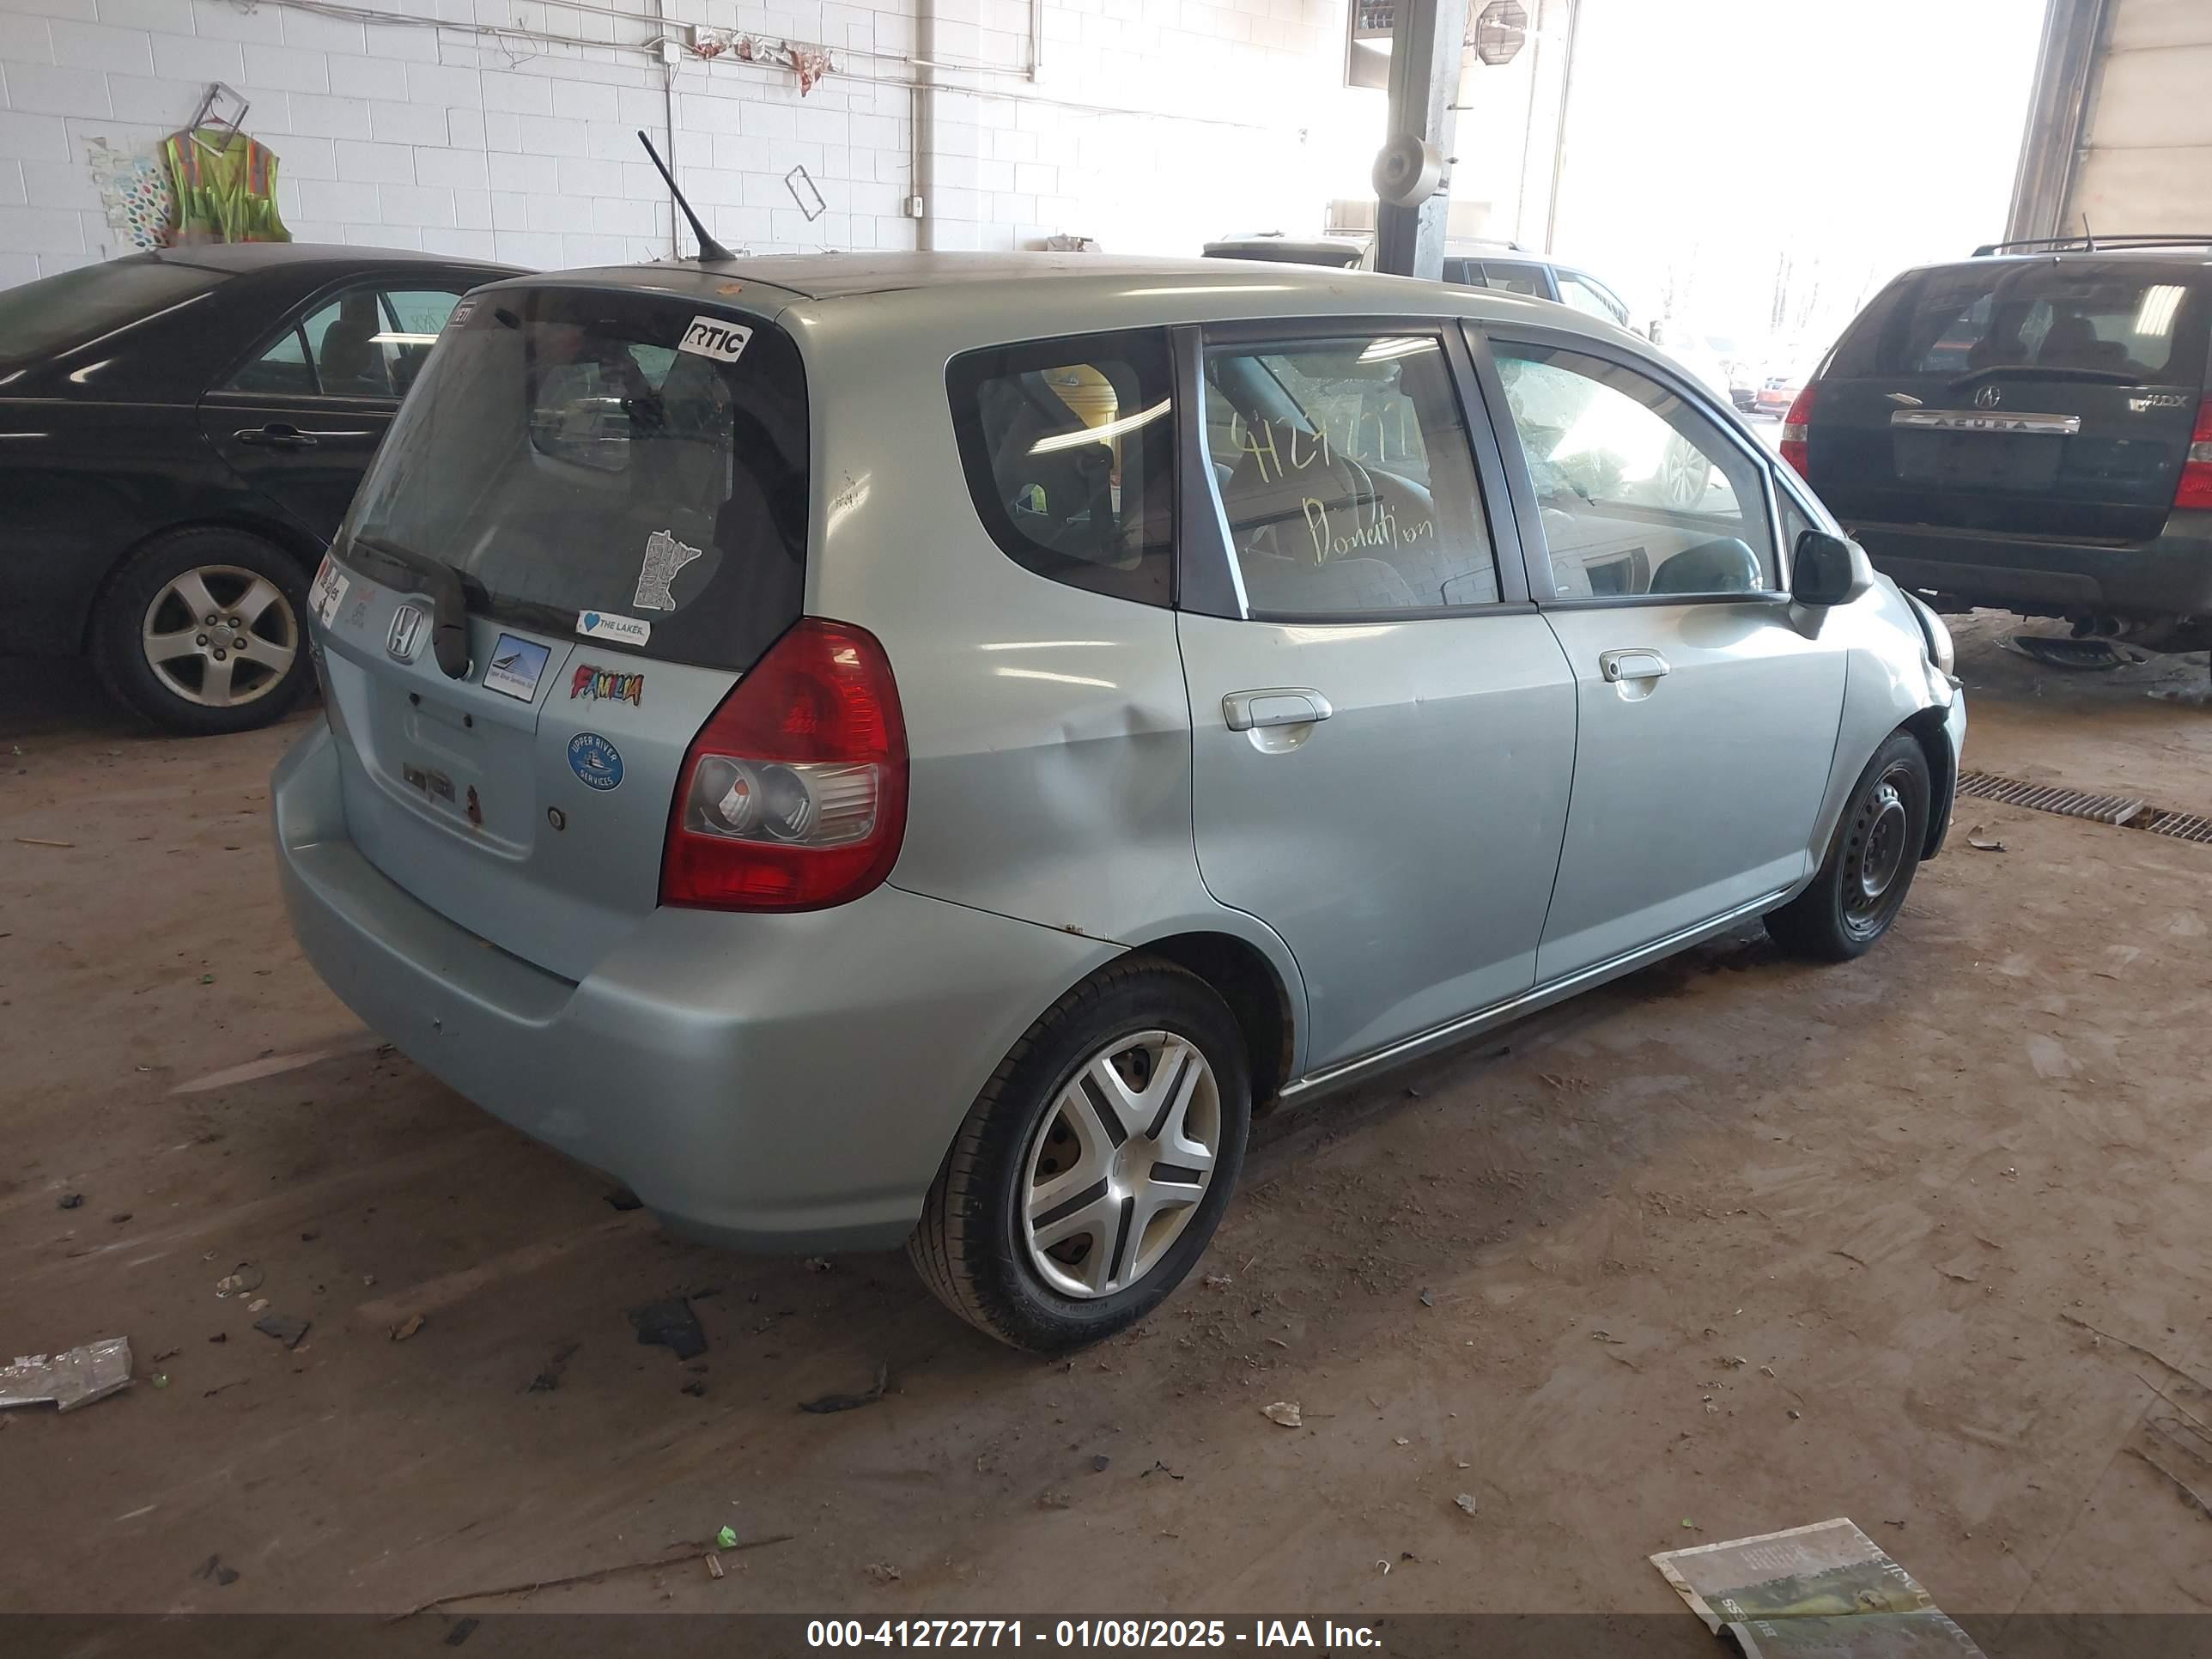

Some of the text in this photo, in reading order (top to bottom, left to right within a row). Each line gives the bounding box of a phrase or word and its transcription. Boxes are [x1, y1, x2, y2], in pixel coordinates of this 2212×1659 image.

[684, 323, 744, 353] RTIC
[1935, 418, 2027, 430] ACURA
[1302, 497, 1433, 567] Donation
[600, 619, 616, 629] THE
[570, 665, 644, 707] FAMILIA
[571, 736, 617, 762] UPPER RIVER
[580, 769, 614, 787] SERVICES
